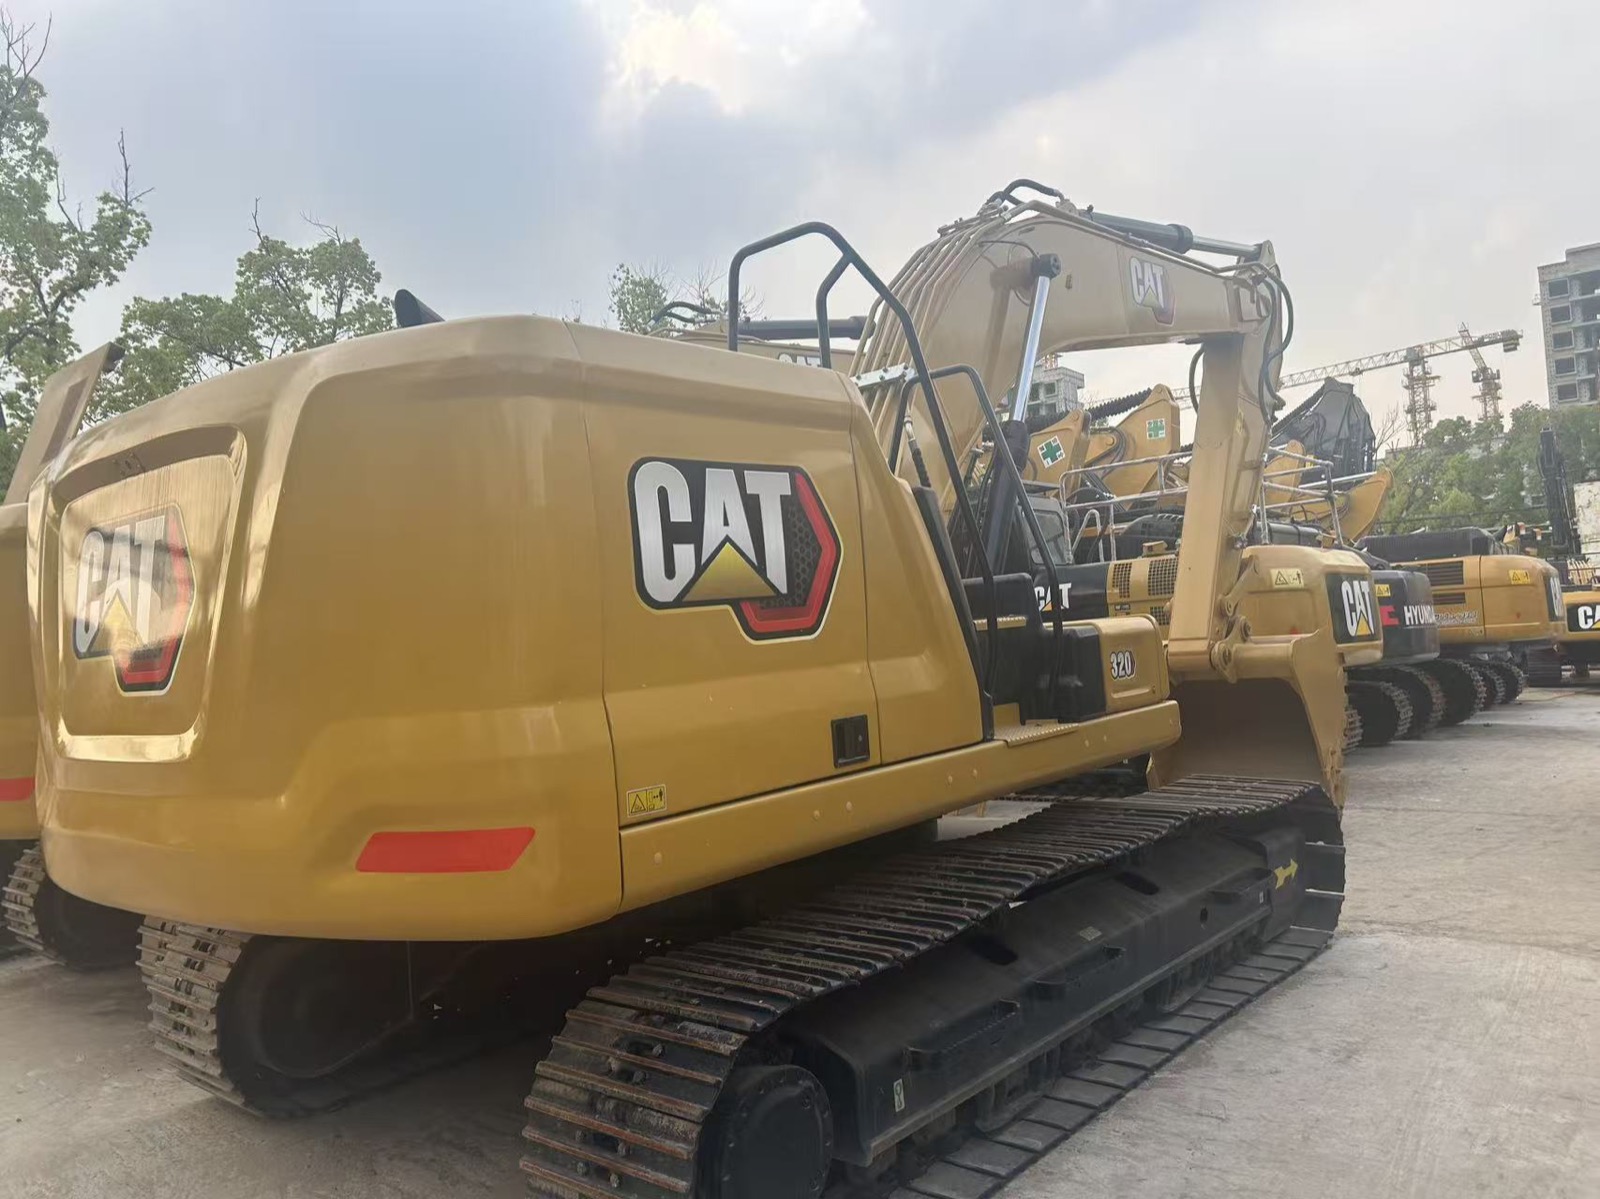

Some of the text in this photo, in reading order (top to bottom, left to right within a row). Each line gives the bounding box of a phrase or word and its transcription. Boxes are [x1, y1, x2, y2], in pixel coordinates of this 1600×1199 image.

[1130, 257, 1165, 308] CAT
[634, 461, 792, 602] CAT
[76, 515, 166, 652] CAT
[1341, 580, 1374, 636] CAT
[1110, 651, 1132, 678] 320
